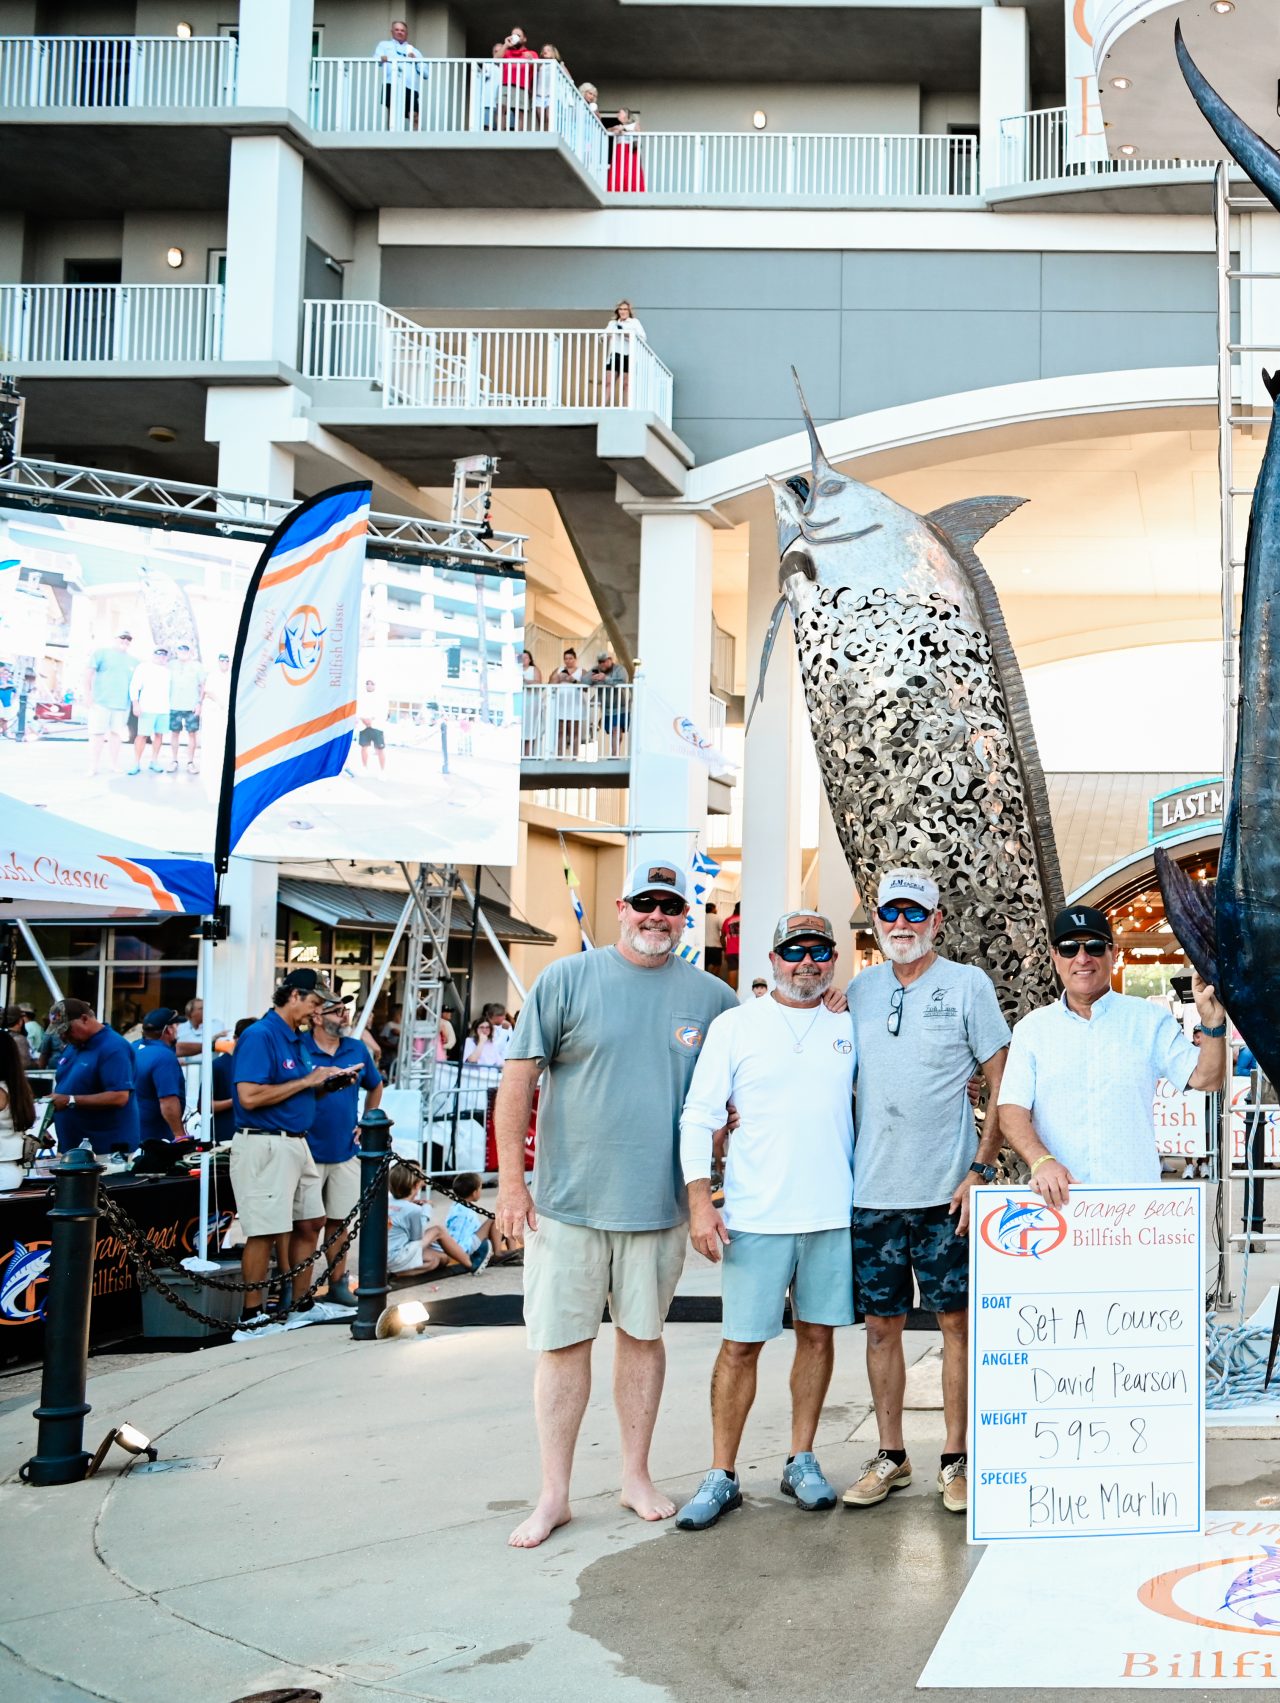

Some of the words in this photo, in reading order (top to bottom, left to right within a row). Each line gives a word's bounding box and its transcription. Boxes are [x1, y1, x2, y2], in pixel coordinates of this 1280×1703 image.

[329, 602, 344, 643] Classic
[329, 647, 343, 687] Billfish
[1162, 791, 1208, 827] LAST
[34, 856, 109, 890] Classic
[1153, 1102, 1197, 1126] fish
[1154, 1132, 1196, 1154] ssic
[1073, 1199, 1137, 1226] Orange
[1144, 1197, 1196, 1220] Beach
[1073, 1228, 1132, 1247] Billfish
[1138, 1227, 1196, 1246] Classic
[93, 1264, 133, 1297] illfish
[981, 1296, 1012, 1309] BOAT
[1016, 1304, 1063, 1346] Set
[1073, 1308, 1088, 1340] A
[1106, 1302, 1183, 1336] Course
[982, 1352, 1029, 1366] ANGLER
[1031, 1366, 1096, 1404] David
[1112, 1362, 1188, 1398] Pearson
[980, 1411, 1028, 1425] WEIGHT
[980, 1471, 1027, 1485] SPECIES
[1029, 1484, 1090, 1528] Blue
[1100, 1480, 1178, 1520] Marlin
